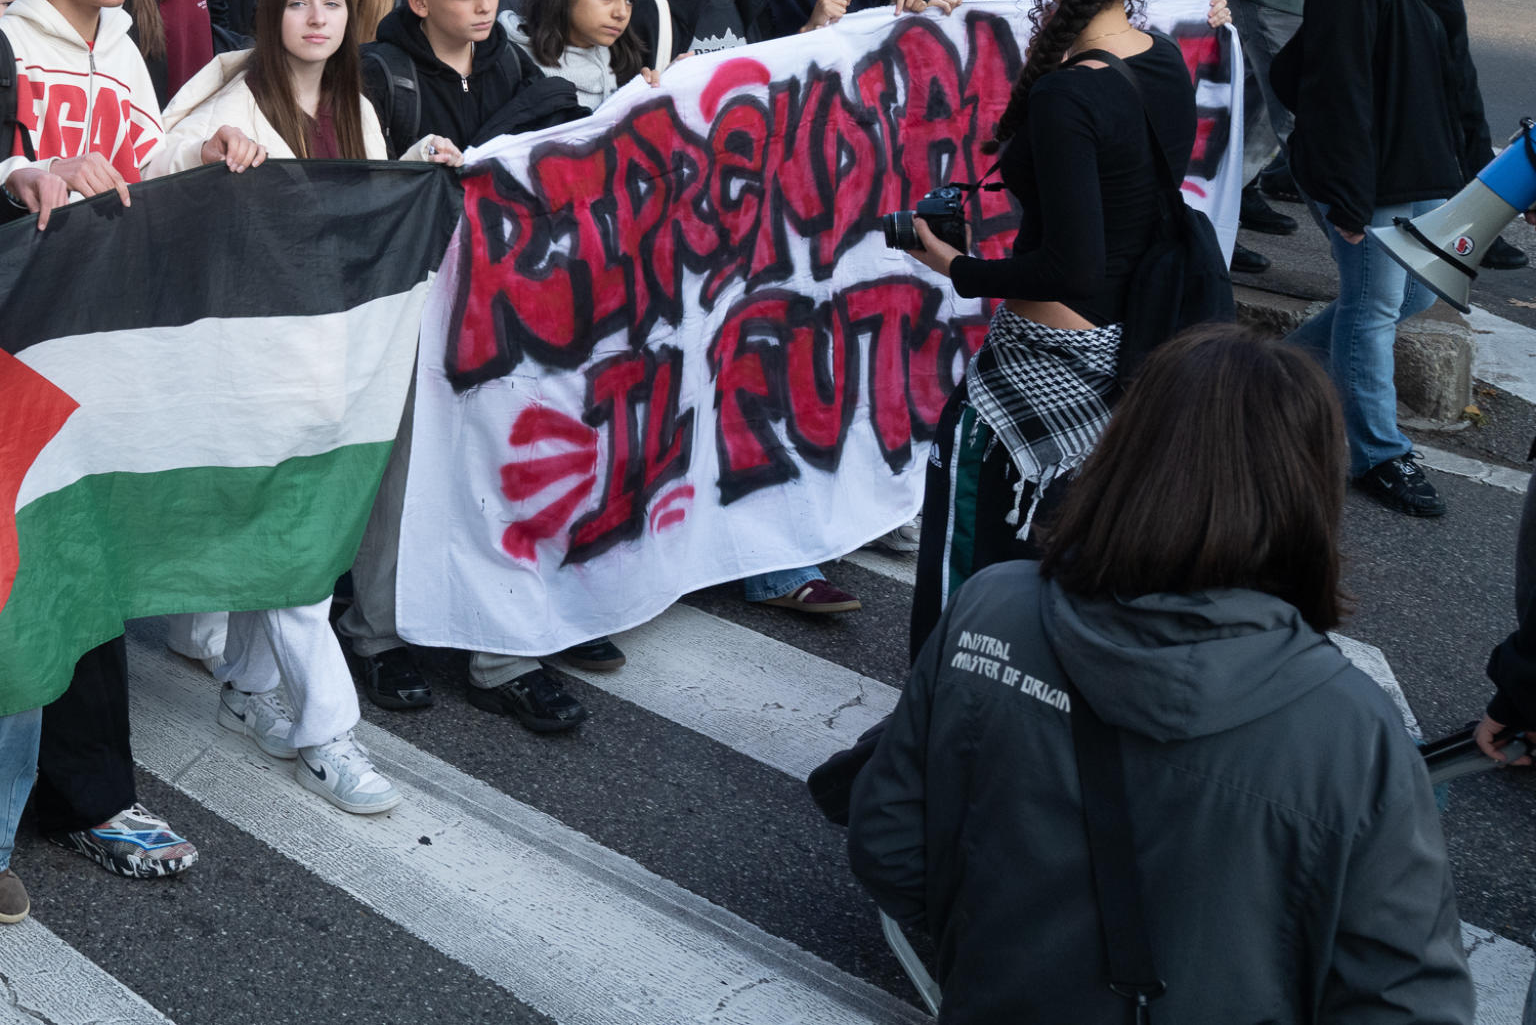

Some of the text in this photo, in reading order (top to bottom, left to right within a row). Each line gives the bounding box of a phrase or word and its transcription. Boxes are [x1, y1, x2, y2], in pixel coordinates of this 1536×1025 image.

[561, 344, 694, 568] IL
[957, 630, 1011, 662] MISTRAL
[950, 651, 1002, 681] MASTER
[1001, 665, 1022, 687] OF
